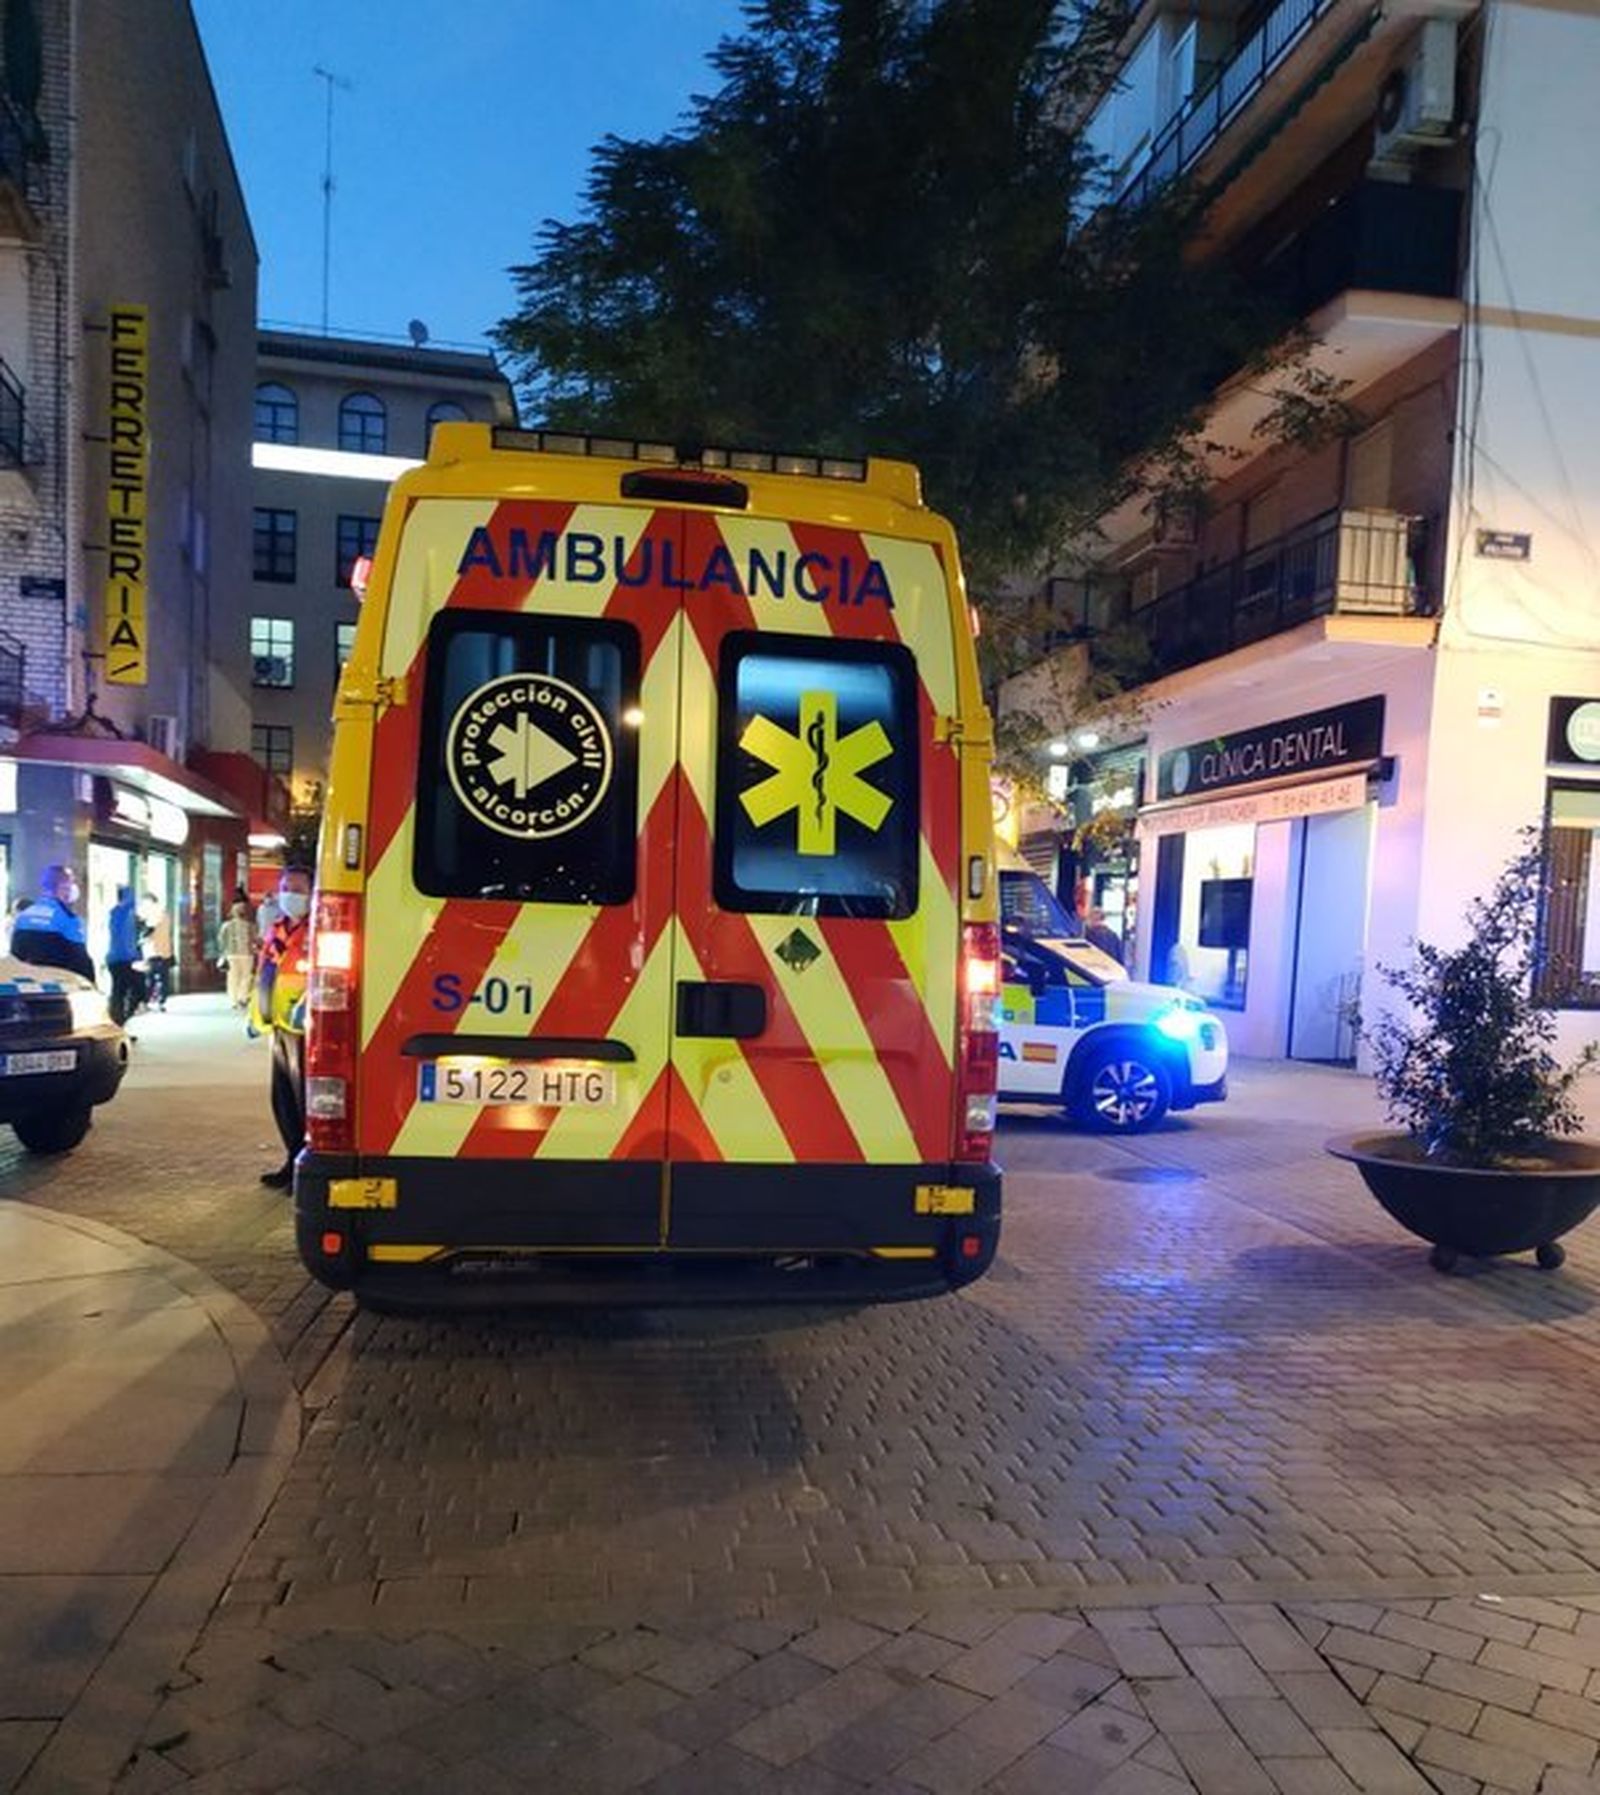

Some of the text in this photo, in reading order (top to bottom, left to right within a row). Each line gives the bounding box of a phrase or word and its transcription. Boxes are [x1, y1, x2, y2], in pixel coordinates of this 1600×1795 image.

[109, 312, 145, 648] FERRETERIA
[456, 525, 897, 611] AMBULANCIA
[461, 683, 603, 769] protección civil
[1268, 720, 1349, 769] DENTAL
[471, 785, 586, 826] alcorcón
[431, 973, 534, 1015] S-01
[446, 1069, 604, 1103] 5122 HTG
